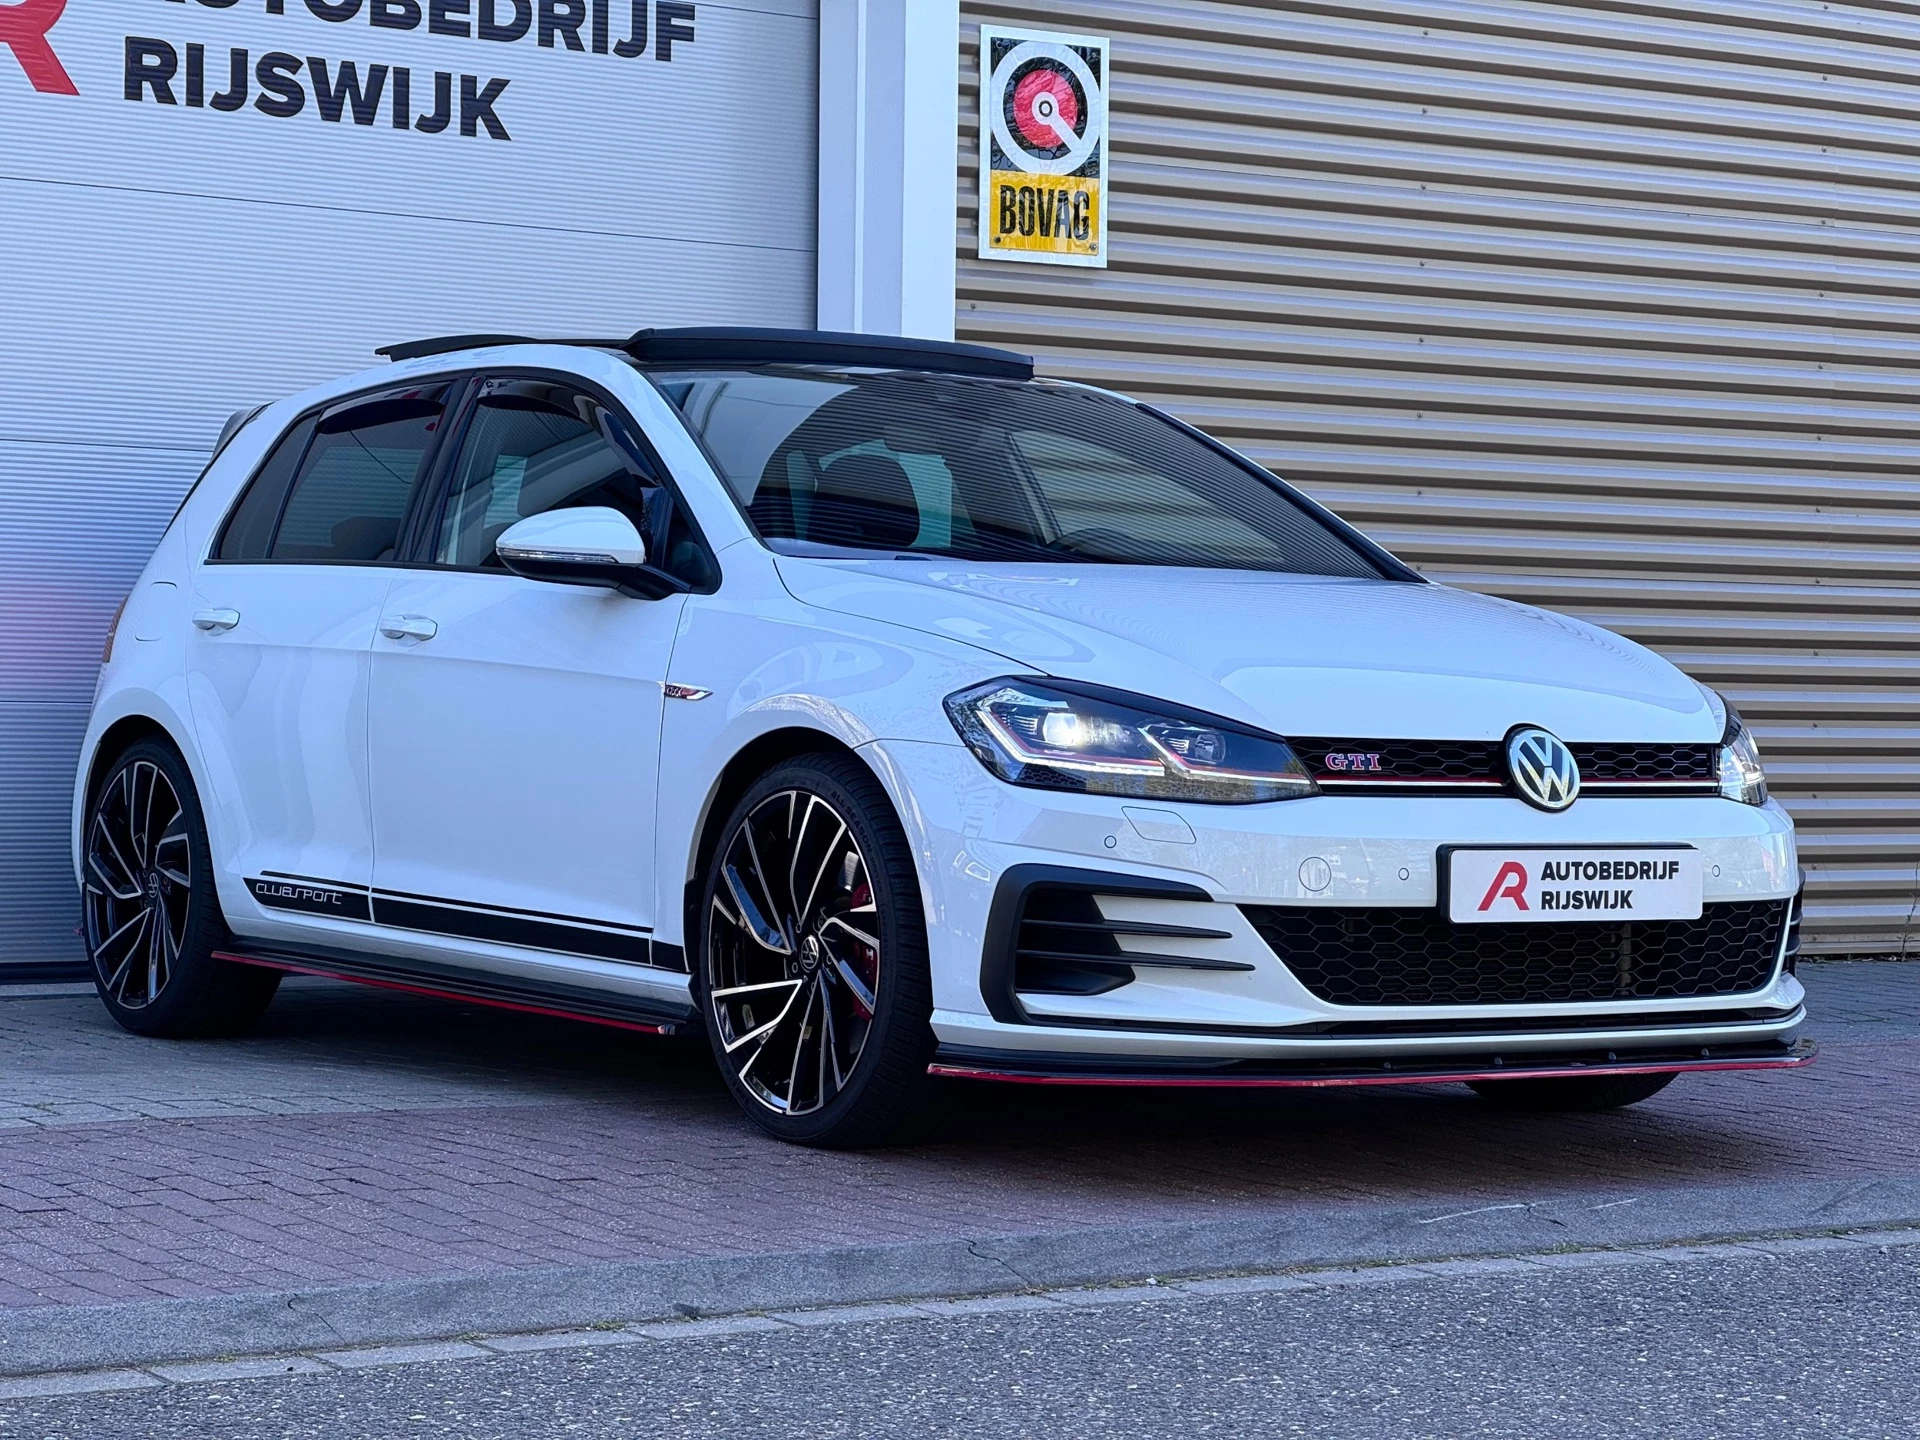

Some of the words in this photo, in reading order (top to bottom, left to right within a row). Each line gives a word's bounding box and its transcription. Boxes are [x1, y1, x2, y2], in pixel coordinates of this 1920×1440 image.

[166, 0, 696, 62] EDRIJF
[124, 36, 512, 141] RIJSWIJK
[1000, 184, 1090, 241] BOVAG
[1325, 753, 1382, 770] GTI
[845, 806, 873, 853] SEASON
[1541, 861, 1679, 880] AUTOBEDRIJF
[1541, 890, 1633, 910] RIJSWIJK
